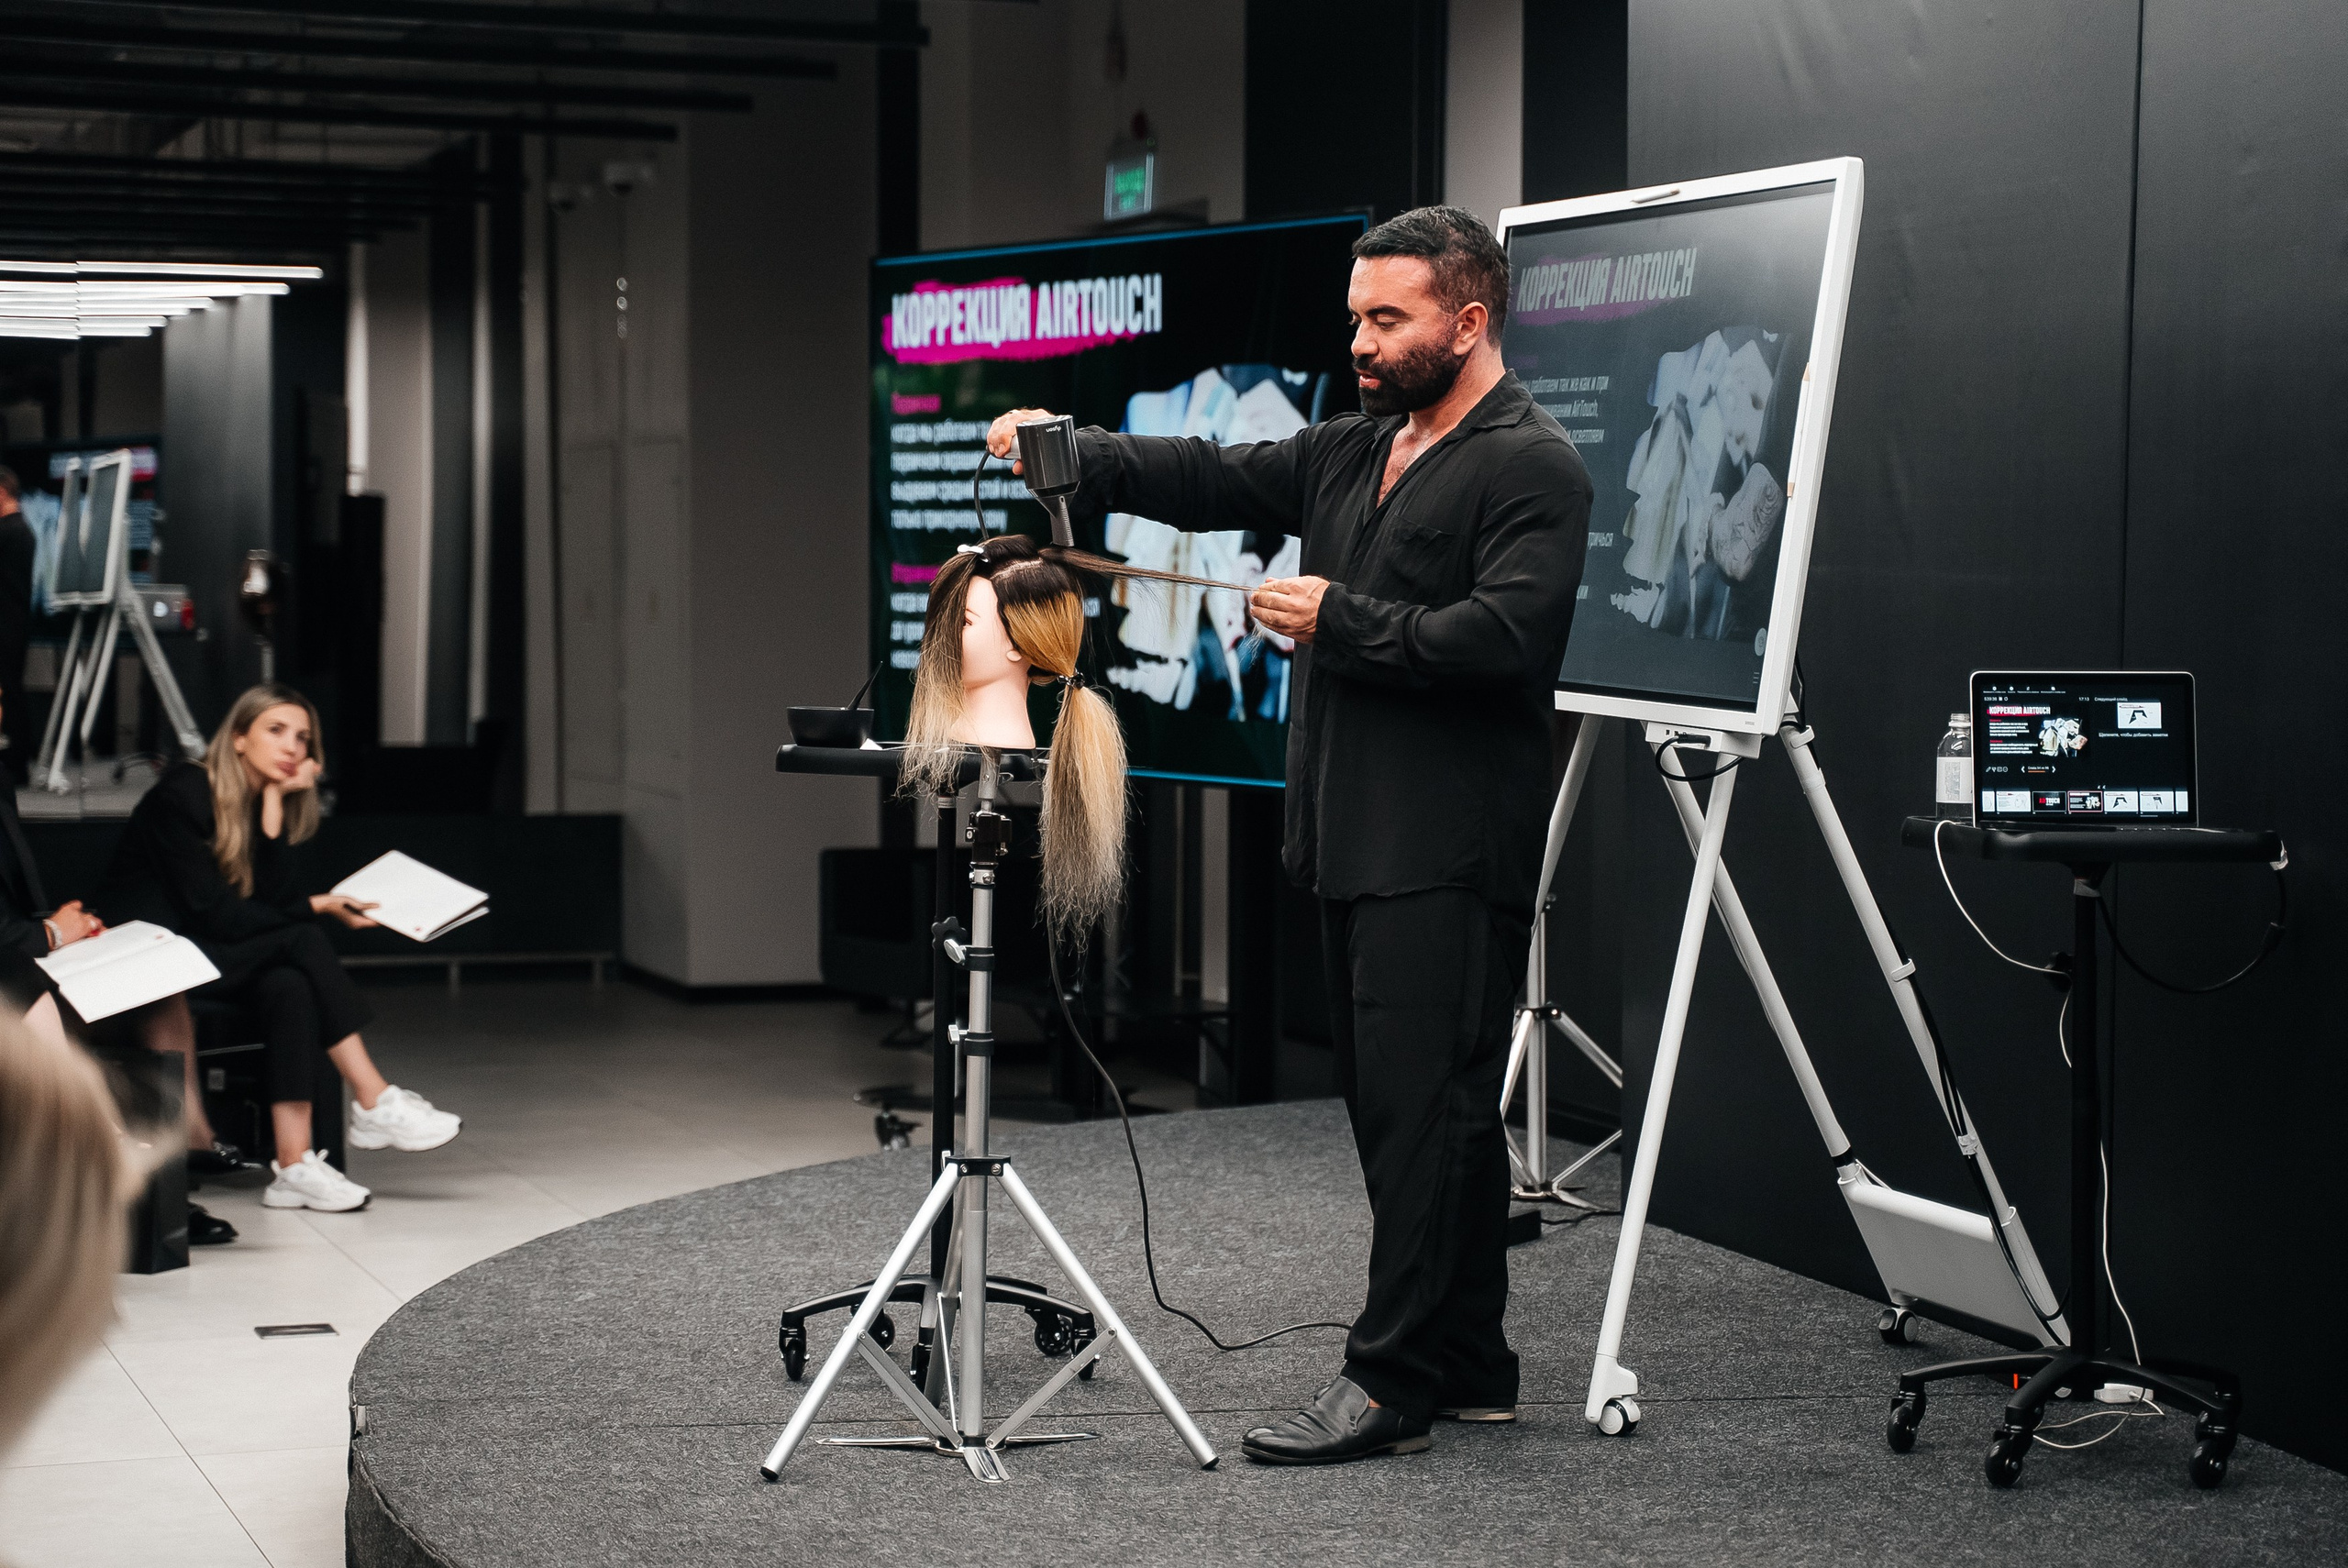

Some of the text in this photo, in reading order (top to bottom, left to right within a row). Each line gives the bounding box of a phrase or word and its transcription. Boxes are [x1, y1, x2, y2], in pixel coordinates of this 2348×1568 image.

[892, 272, 1163, 348] КОРРЕКЦИЯ AIRTOUCH
[1516, 248, 1697, 311] КОРРЕКЦИЯ AIRTOUCH
